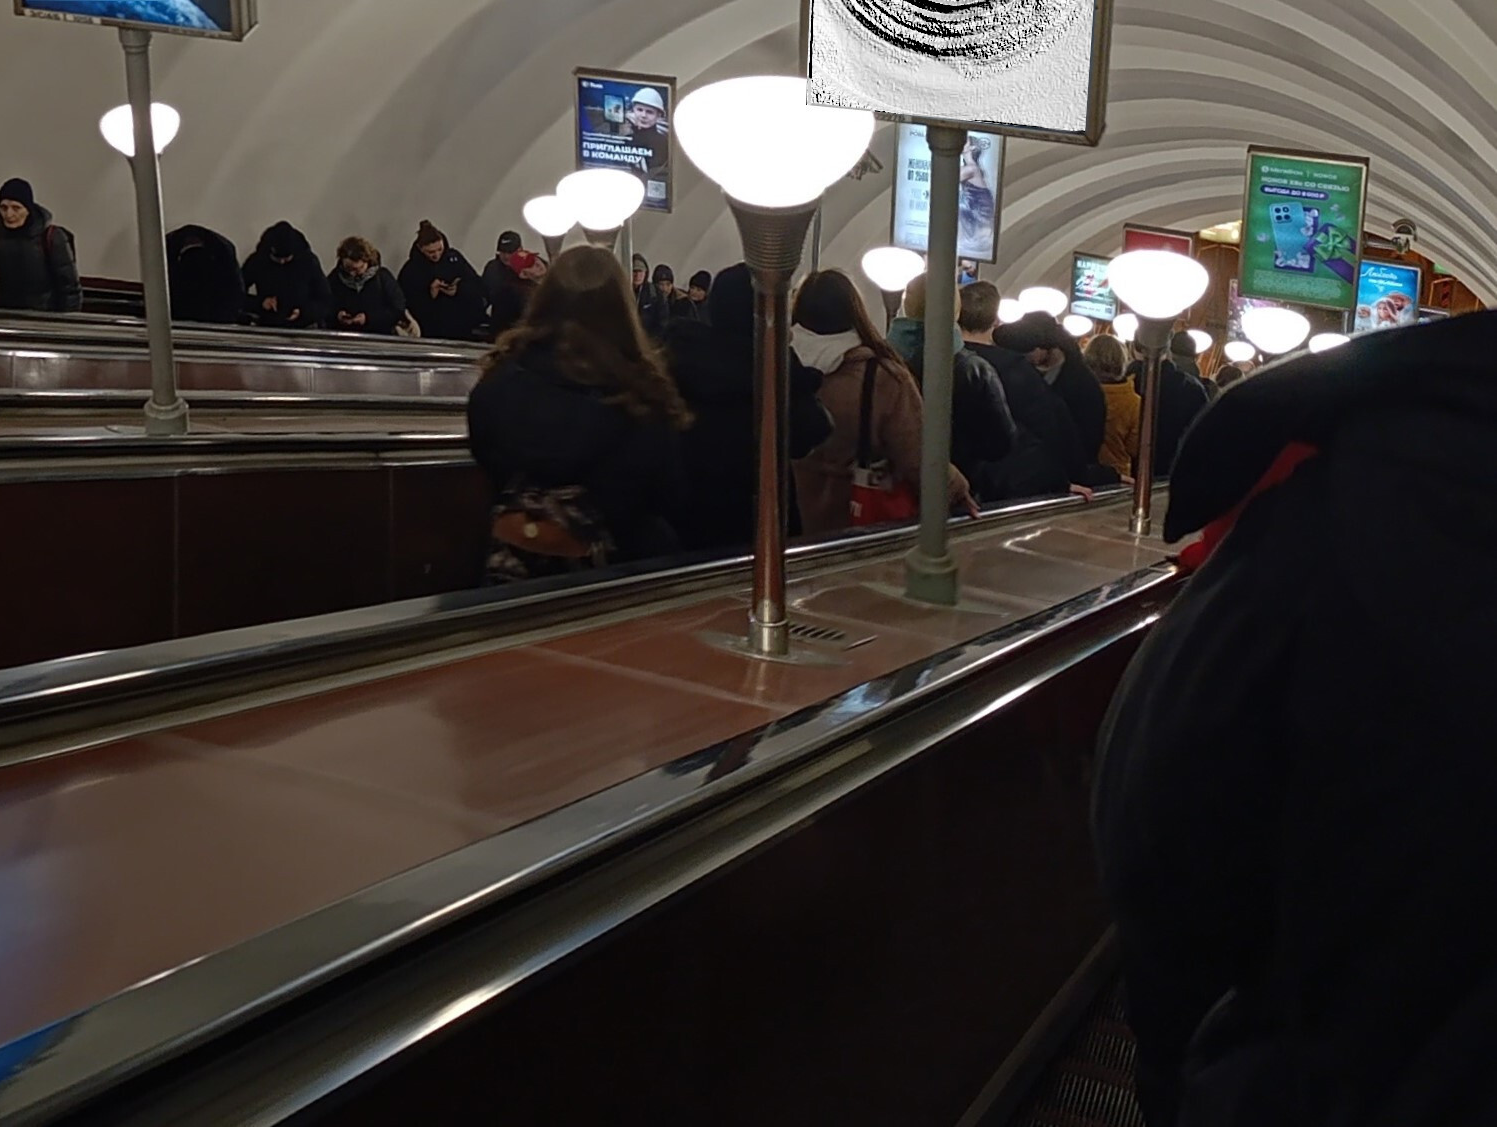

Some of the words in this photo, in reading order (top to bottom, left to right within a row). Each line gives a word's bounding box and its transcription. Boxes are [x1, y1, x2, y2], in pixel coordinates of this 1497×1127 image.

[582, 141, 653, 157] ПРИГЛАШАЕМ
[582, 149, 590, 158] В
[592, 150, 642, 164] КОМАНДУ
